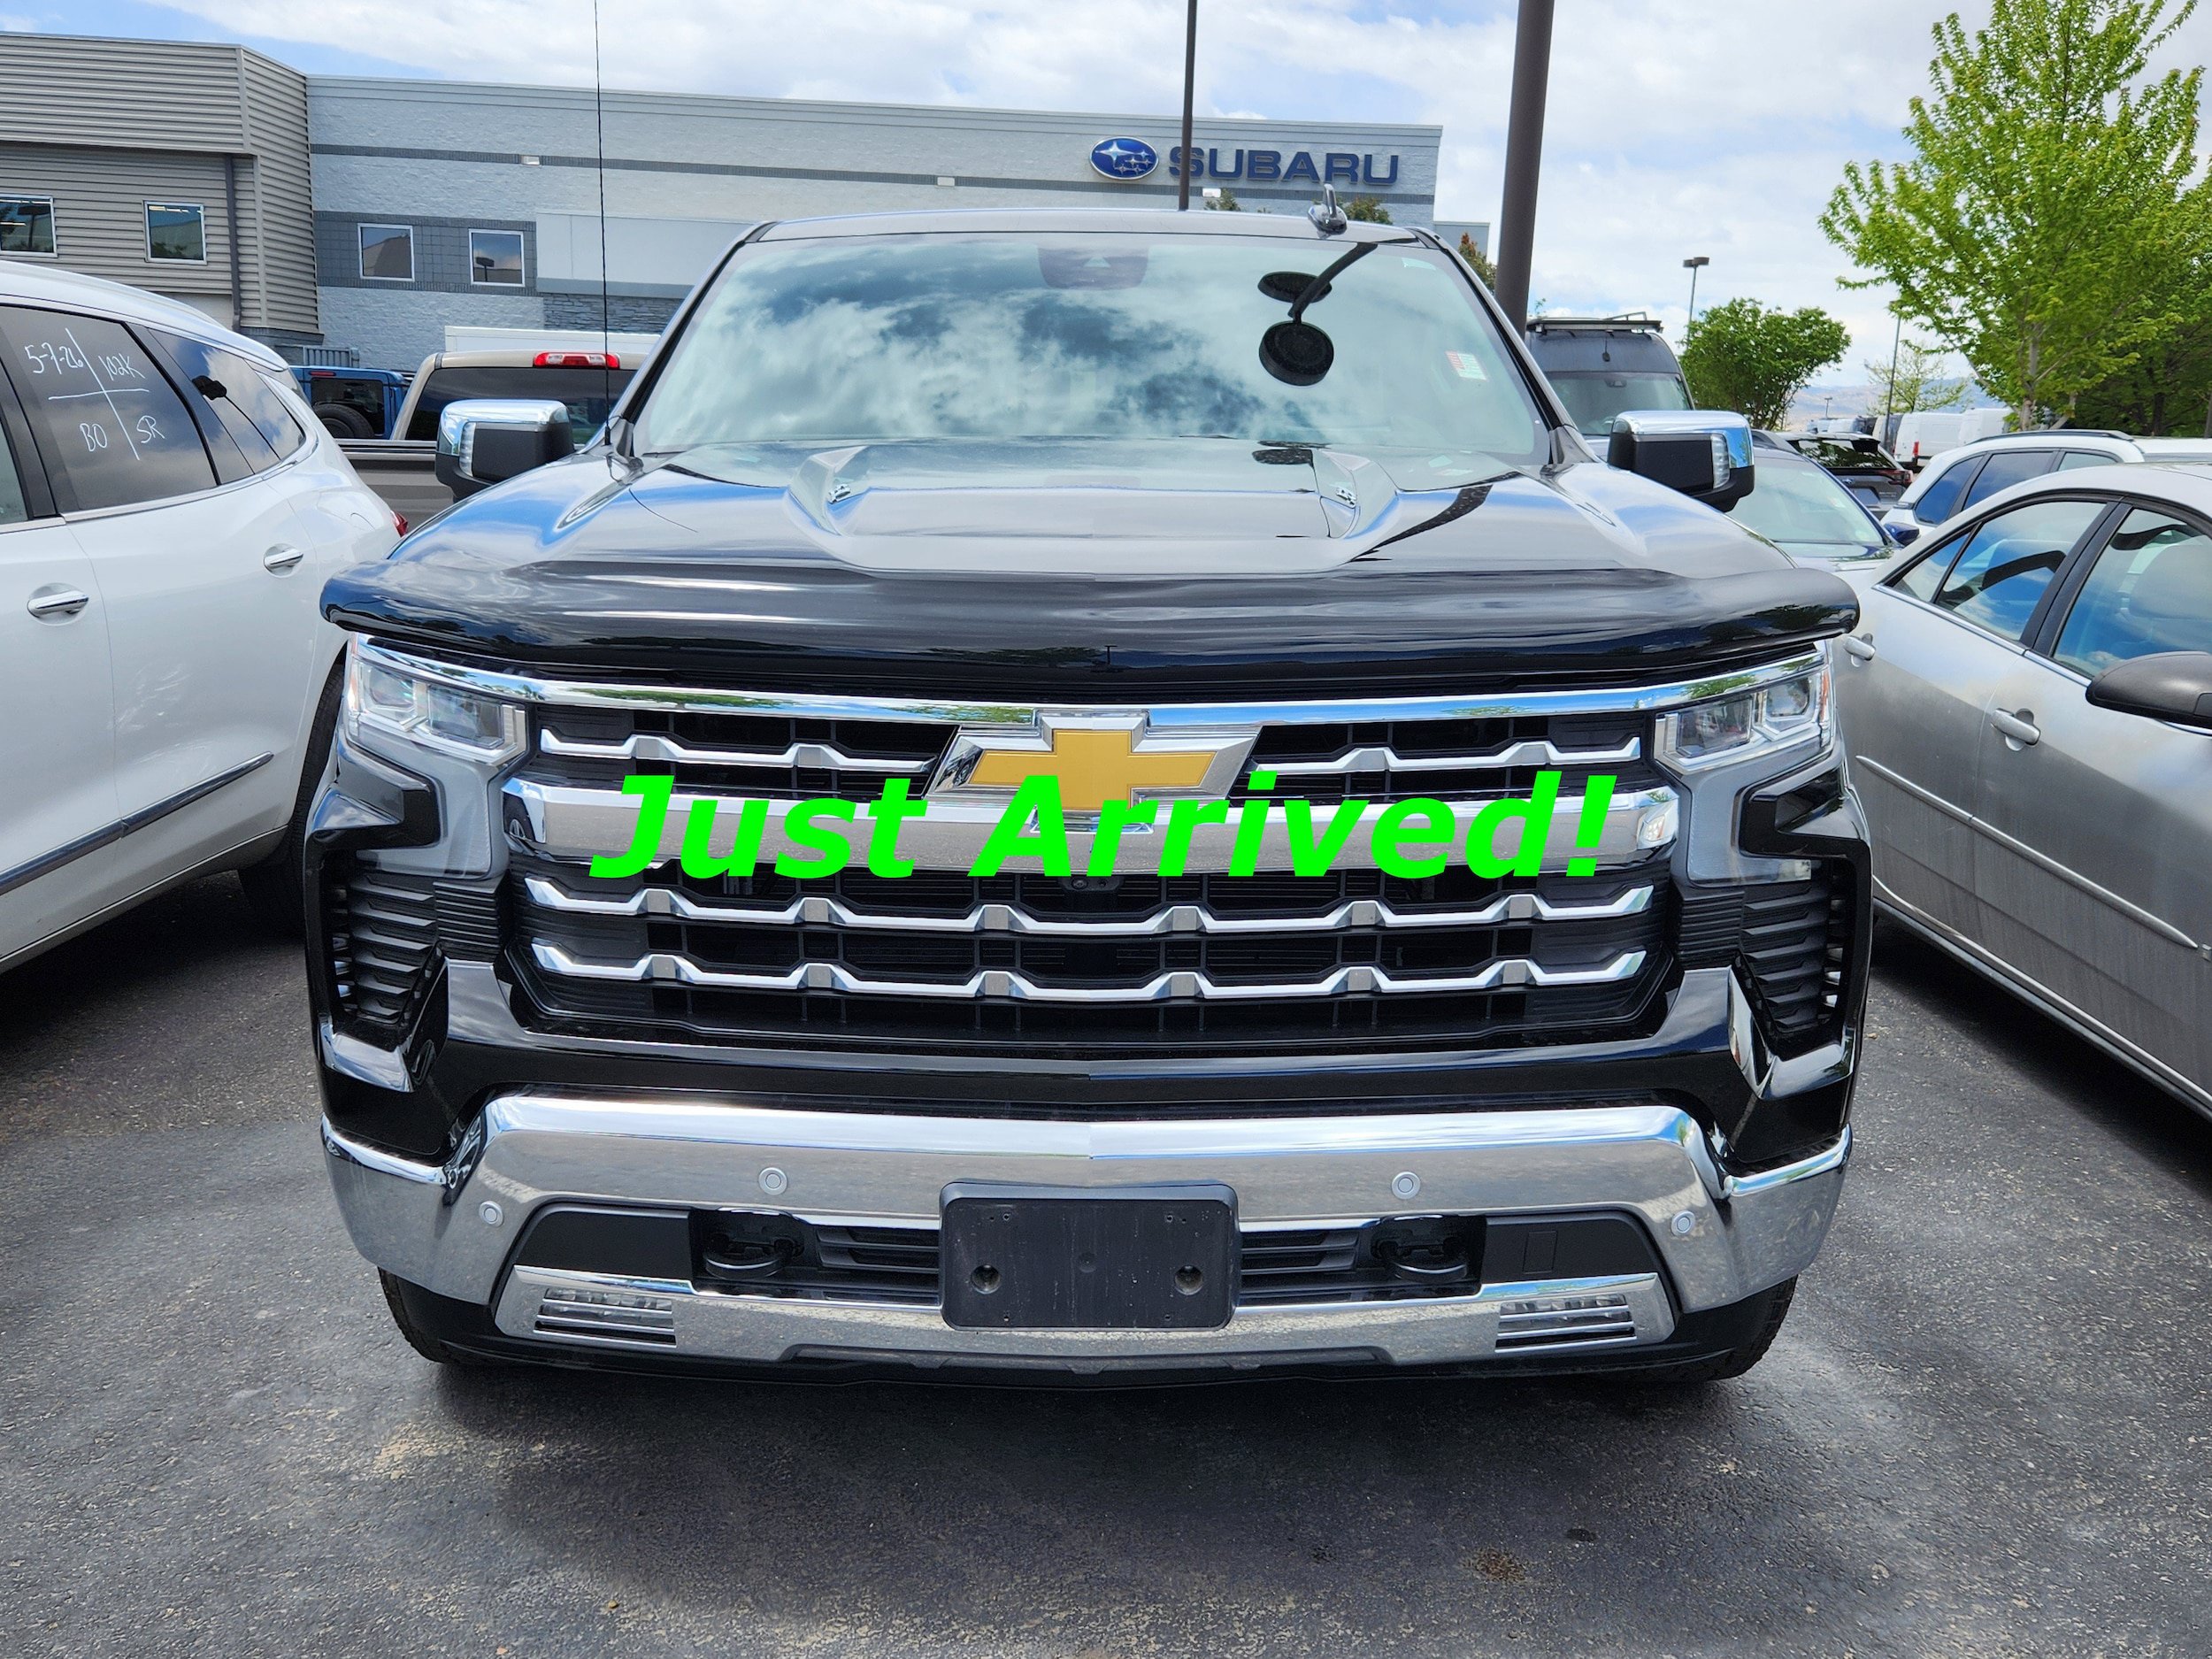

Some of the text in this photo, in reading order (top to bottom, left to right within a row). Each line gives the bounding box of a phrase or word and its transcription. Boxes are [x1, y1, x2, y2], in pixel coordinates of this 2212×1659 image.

[1169, 146, 1399, 186] SUBARU
[98, 353, 146, 380] 102K
[136, 415, 165, 443] SR
